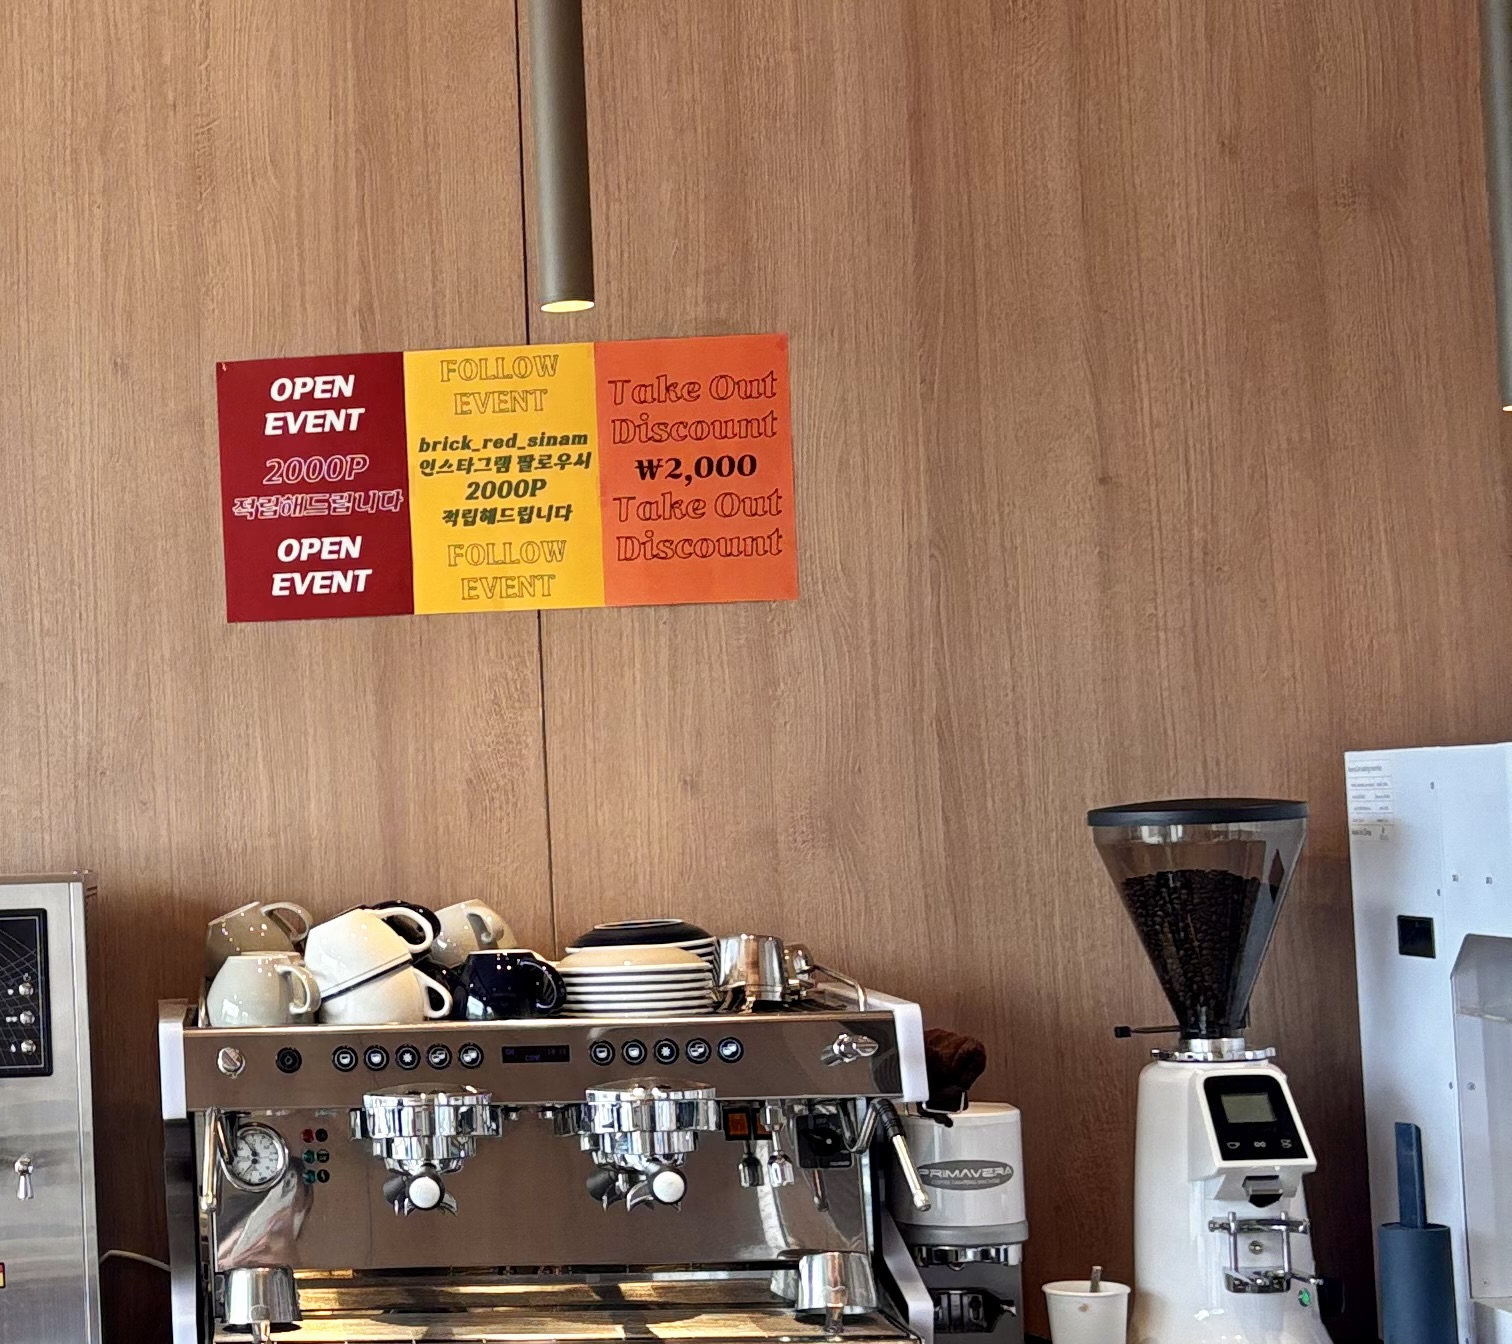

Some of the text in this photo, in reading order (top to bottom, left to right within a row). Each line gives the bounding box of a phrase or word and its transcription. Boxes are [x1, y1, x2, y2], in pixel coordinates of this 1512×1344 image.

[440, 354, 559, 383] FOLLOW
[269, 374, 355, 402] OPEN
[453, 388, 548, 416] EVENT
[607, 370, 779, 407] Take Out
[263, 407, 365, 436] EVENT
[611, 409, 780, 446] Discount
[418, 431, 589, 453] brick_red_sinam
[262, 455, 369, 484] 2000P
[419, 451, 591, 476] 인스타그램 팔로우시
[634, 453, 758, 488] ₩2,000
[465, 478, 547, 501] 2000P
[232, 489, 404, 519] 적립해드립니다
[441, 504, 573, 527] 적립해드립니다
[613, 487, 783, 524] Take Out
[277, 535, 362, 563] OPEN
[447, 539, 567, 567] FOLLOW
[616, 526, 784, 564] Discount
[271, 568, 373, 597] EVENT
[460, 574, 556, 601] EVENT
[918, 1166, 1013, 1179] PRIMAVERA
